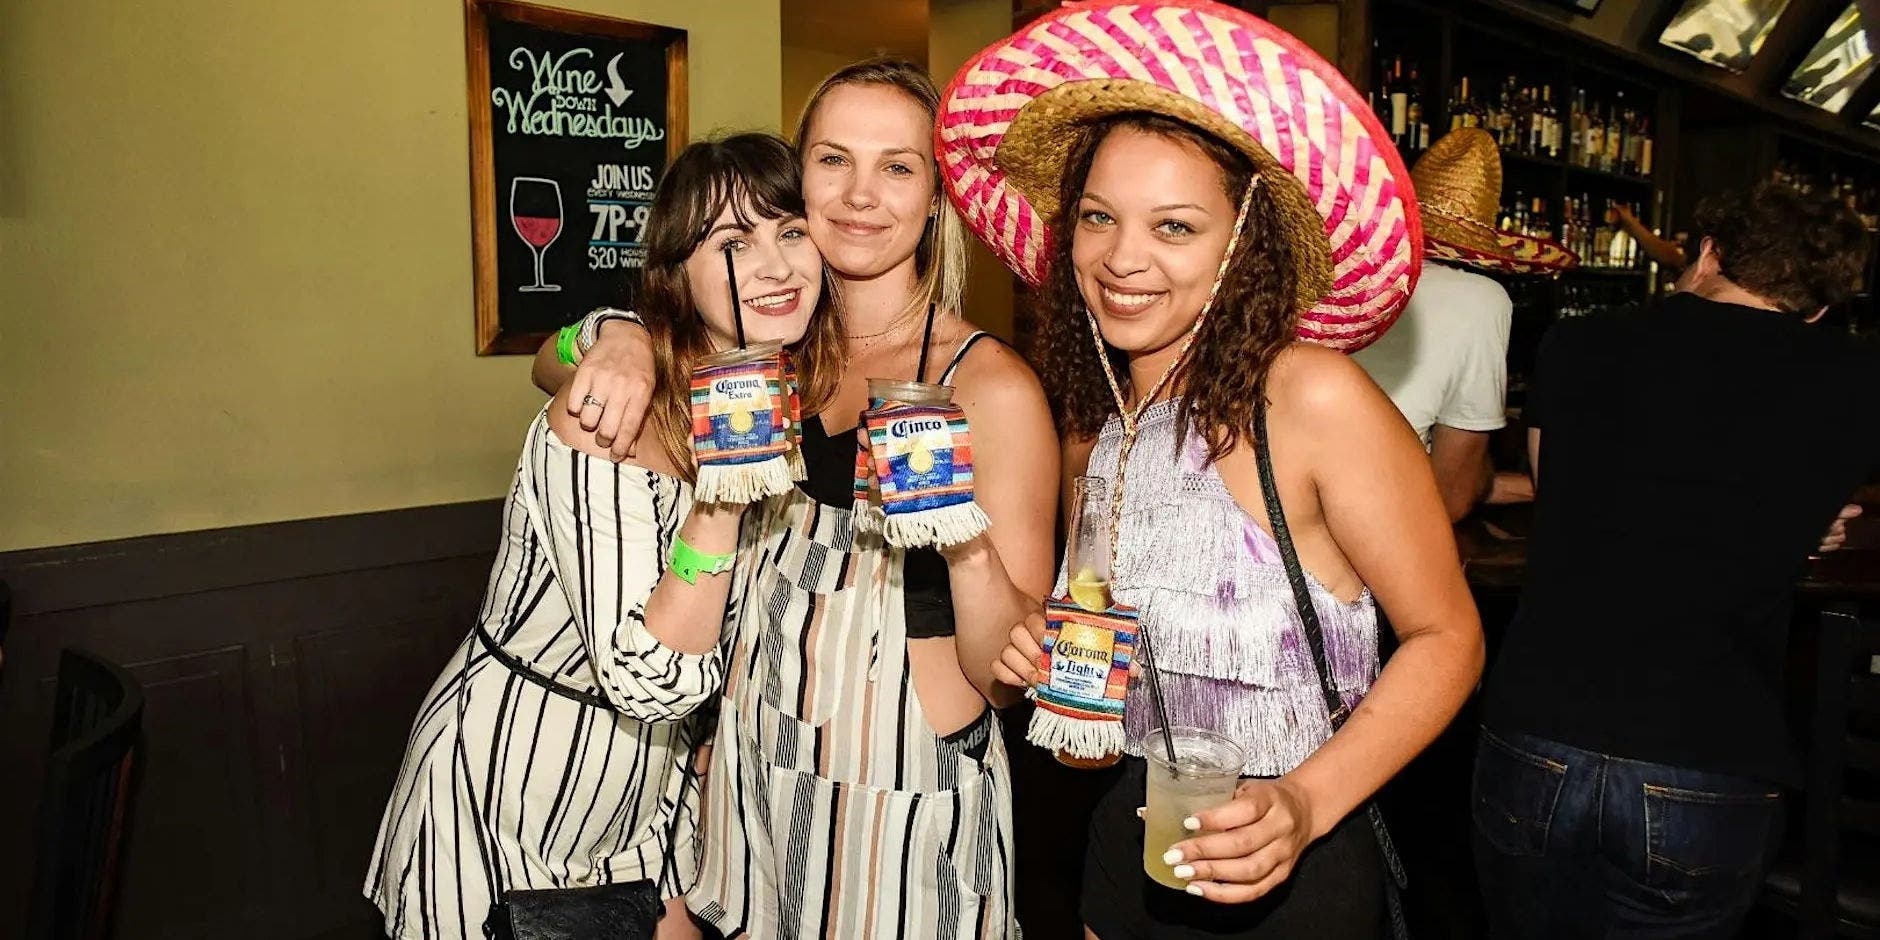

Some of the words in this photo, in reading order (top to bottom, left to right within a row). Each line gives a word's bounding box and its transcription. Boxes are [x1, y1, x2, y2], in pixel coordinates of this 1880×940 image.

[509, 47, 603, 95] Wine
[554, 95, 597, 112] DOWN
[491, 86, 664, 149] Wednesdays
[591, 164, 630, 190] JOIN
[631, 165, 654, 191] US
[589, 204, 651, 242] 7P-9
[588, 246, 618, 270] $20
[619, 256, 645, 268] WIN
[715, 378, 762, 395] Corona
[728, 392, 753, 400] Extra
[891, 420, 942, 438] Cinco
[1056, 639, 1109, 664] Corona
[1066, 660, 1095, 678] Light
